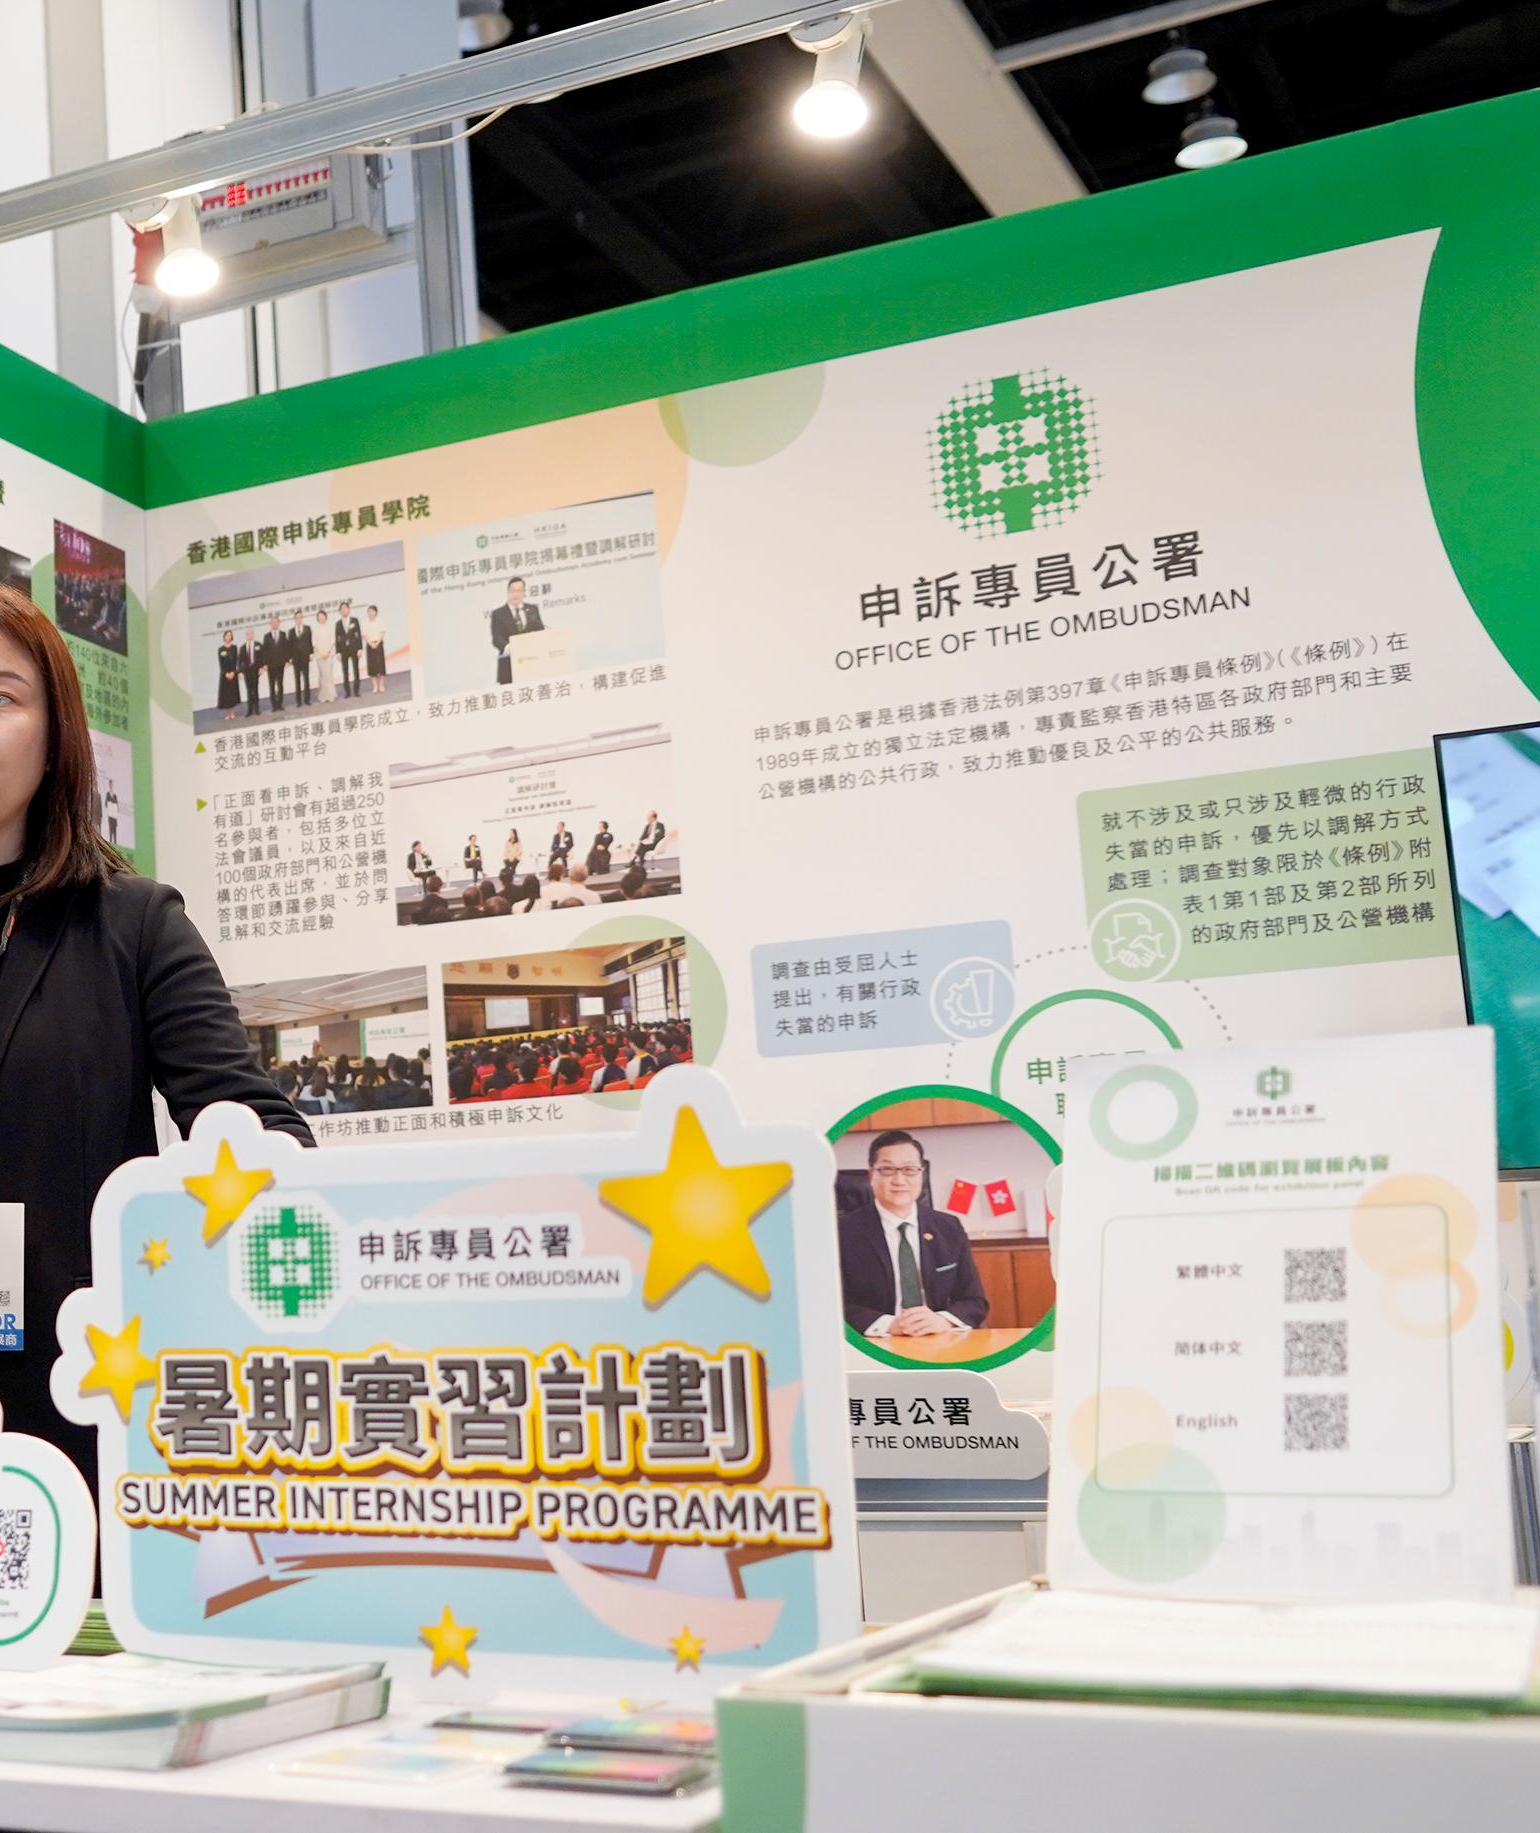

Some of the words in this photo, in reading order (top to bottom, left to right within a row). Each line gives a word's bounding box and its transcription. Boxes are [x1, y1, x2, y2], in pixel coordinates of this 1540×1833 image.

[186, 494, 431, 565] 香港國際申訴專員學院
[860, 530, 1204, 630] 申訴專員公署
[835, 636, 932, 671] OFFICE
[939, 628, 976, 655] OF
[986, 617, 1040, 646] THE
[1050, 586, 1252, 638] OMBUDSMAN
[214, 743, 327, 772] 交流的互動平台
[1101, 773, 1426, 832] 就不涉及或只涉及輕微的行政
[1182, 869, 1435, 915] 表1第1部及第2部所列
[218, 914, 335, 942] 見解和交流經驗
[1192, 902, 1435, 945] 的政府部門及公營機構
[771, 950, 918, 981] 調查由受屈人士
[776, 1010, 878, 1037] 失當的申訴
[359, 1225, 572, 1265] 申訴專員公署
[361, 1274, 421, 1290] OFFICE
[428, 1273, 452, 1289] OF
[458, 1272, 491, 1288] THE
[495, 1269, 621, 1288] OMBUDSMAN
[159, 1350, 749, 1464] 暑期實習計劃
[1175, 1412, 1238, 1430] English
[865, 1436, 898, 1449] THE
[903, 1436, 1019, 1449] OMBUDSMAN
[121, 1481, 277, 1521] SUMMER
[288, 1483, 523, 1526] INTERNSHIP
[537, 1493, 818, 1535] PROGRAMME
